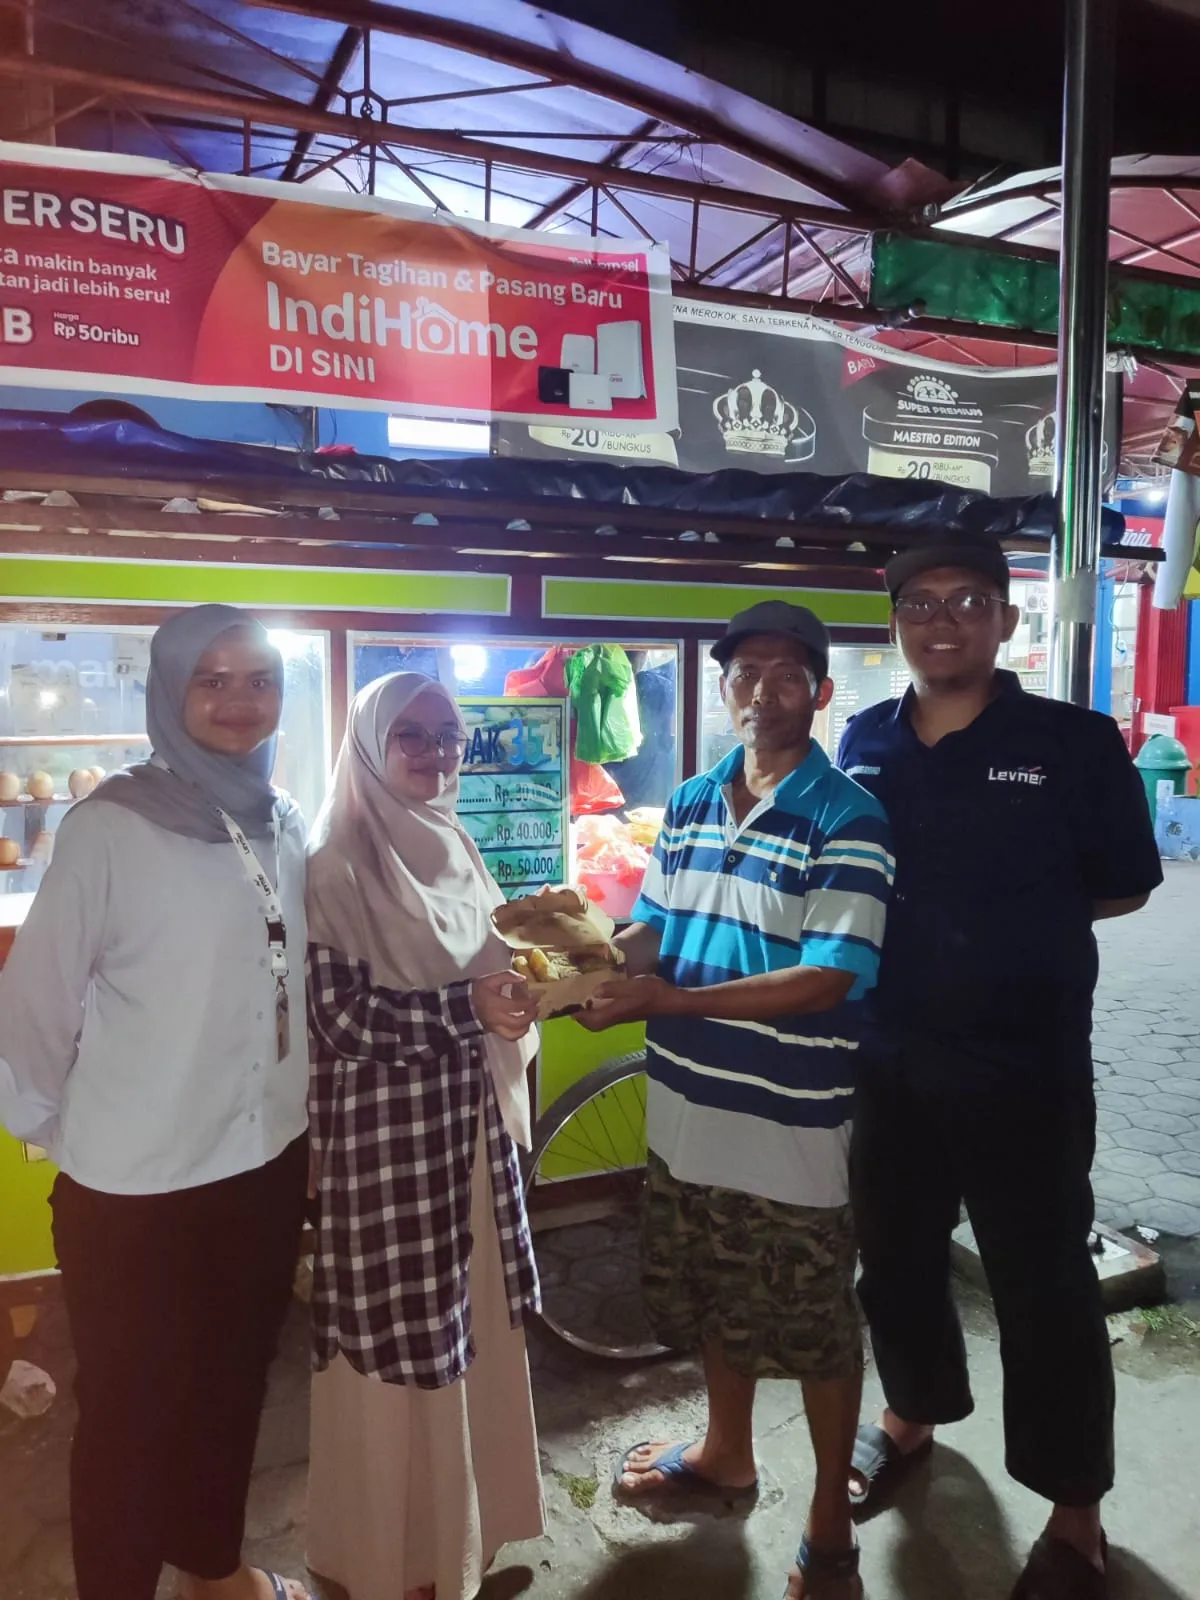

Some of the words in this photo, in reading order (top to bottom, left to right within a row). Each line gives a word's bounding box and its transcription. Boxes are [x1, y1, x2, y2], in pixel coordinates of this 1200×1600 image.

[3, 189, 61, 228] ER
[70, 197, 185, 254] SERU
[0, 248, 18, 265] a
[25, 254, 84, 273] makin
[88, 258, 157, 281] banyak
[262, 241, 341, 276] Bayar
[347, 252, 447, 288] Tagihan
[453, 269, 474, 292] &
[480, 271, 566, 306] Pasang
[571, 282, 622, 309] Baru
[33, 275, 69, 294] jadi
[73, 279, 120, 298] lebih
[124, 289, 171, 304] seru!
[267, 281, 538, 360] IndiHome
[742, 314, 765, 325] SAYA
[768, 317, 809, 330] TERKENA
[54, 322, 76, 339] Rp
[79, 325, 139, 346] 50ribu
[270, 344, 303, 374] DI
[312, 349, 375, 382] SINI
[918, 385, 949, 400] 234
[897, 399, 931, 414] SUPER
[933, 406, 983, 417] PREMIUM
[571, 428, 599, 448] 20
[601, 440, 652, 454] /BUNGKUS
[893, 430, 940, 446] MAESTRO
[943, 434, 981, 447] EDITION
[906, 461, 931, 480] 20
[508, 717, 558, 766] 354
[988, 767, 1047, 786] Levner
[495, 784, 513, 807] Rp.
[496, 824, 514, 845] Rp.
[516, 821, 559, 843] 40.000,-
[498, 859, 516, 882] Rp.
[518, 857, 560, 880] 50.000,-
